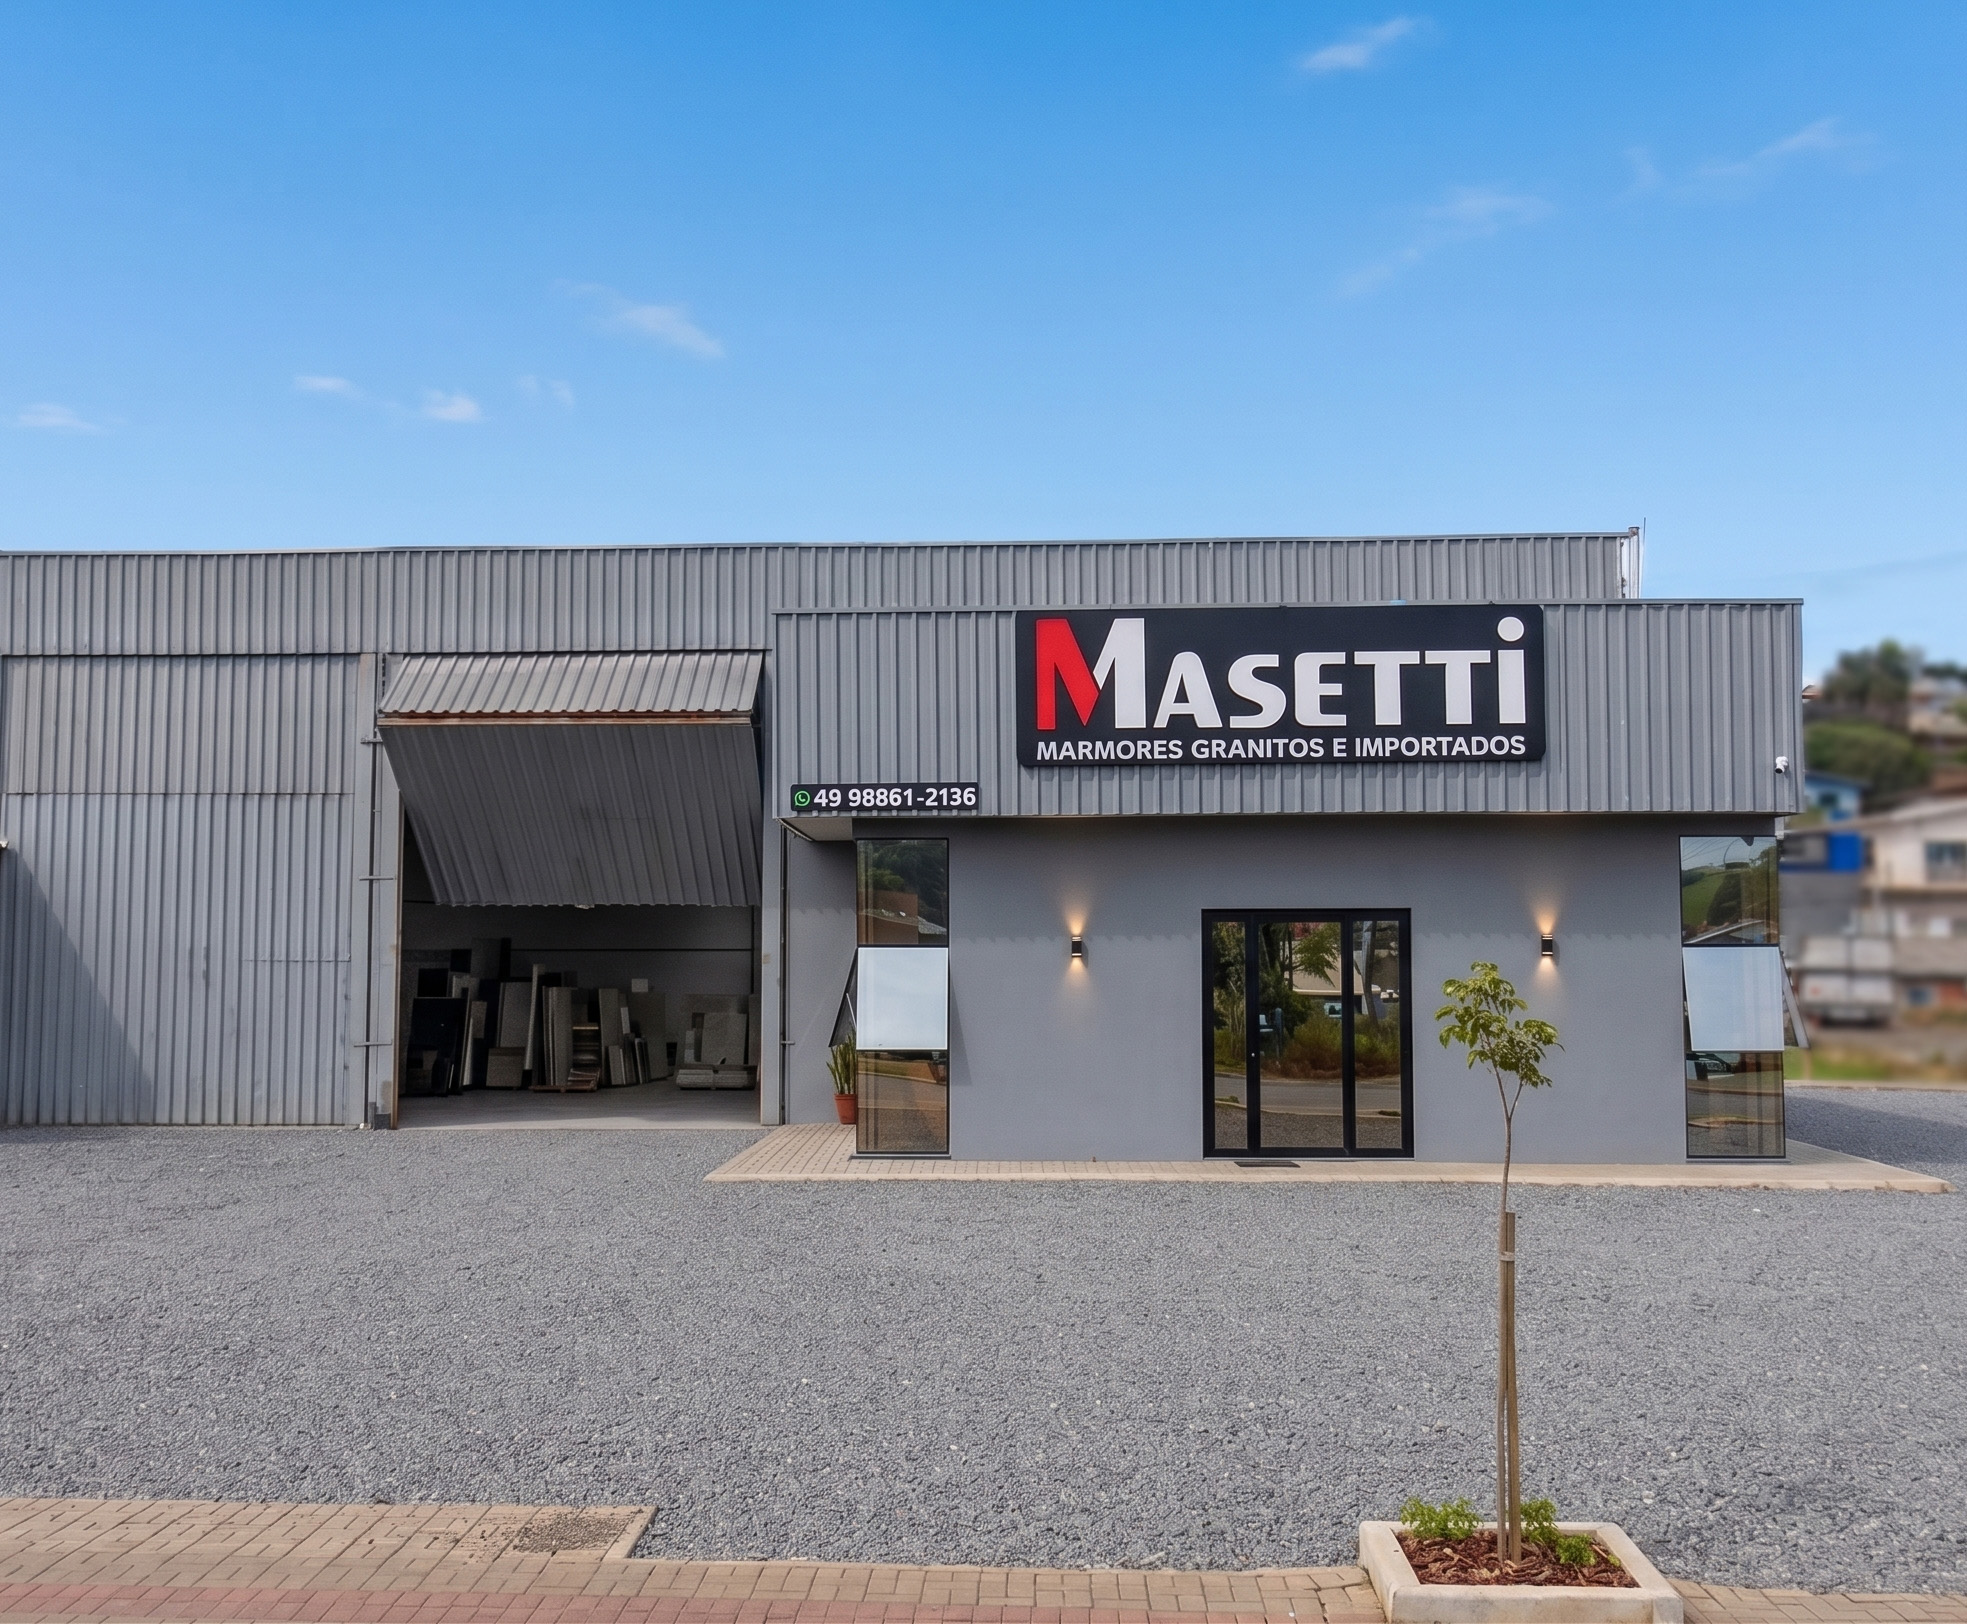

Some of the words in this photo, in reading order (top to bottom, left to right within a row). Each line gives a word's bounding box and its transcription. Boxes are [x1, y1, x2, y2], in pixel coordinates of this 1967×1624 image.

[1036, 740, 1183, 760] MARMORES
[1191, 738, 1324, 758] GRANITOS
[1333, 738, 1346, 757] E
[1356, 735, 1526, 756] IMPORTADOS
[813, 788, 842, 807] 49
[848, 787, 977, 807] 98861-2136
